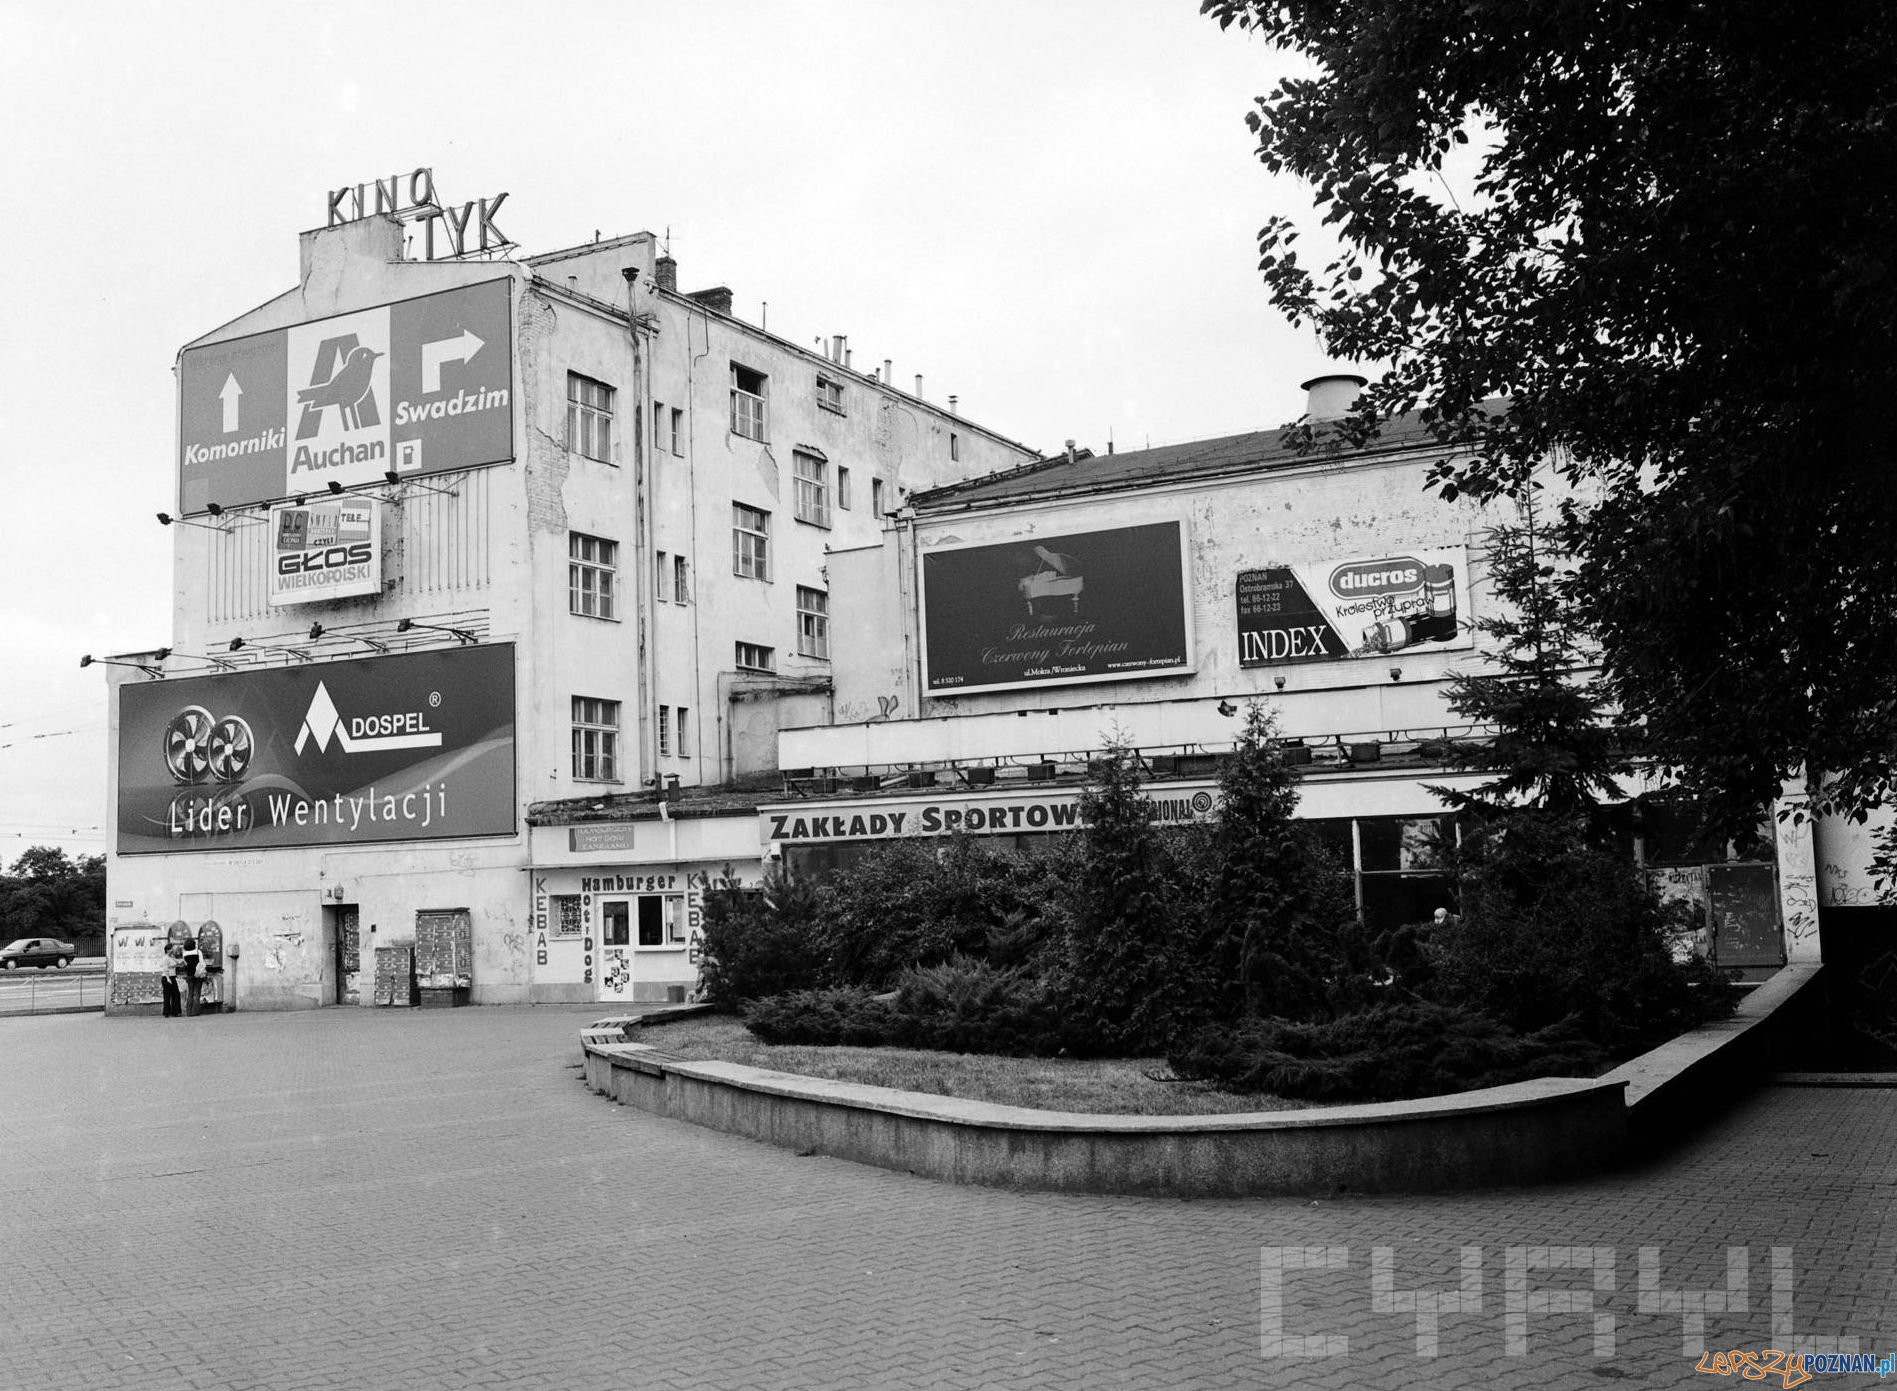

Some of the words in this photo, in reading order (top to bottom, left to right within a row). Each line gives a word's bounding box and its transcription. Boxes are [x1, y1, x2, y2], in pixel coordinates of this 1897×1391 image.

[327, 166, 432, 227] KINO
[394, 387, 510, 427] Swadzim
[184, 426, 287, 466] Komorniki
[290, 439, 386, 475] Auchan
[278, 542, 373, 576] GŁOS
[278, 564, 371, 591] WIELKOPOLSKI
[1339, 568, 1418, 590] ducros
[1006, 621, 1097, 643] Restauracja
[1241, 624, 1329, 661] INDEX
[980, 647, 1051, 665] Czerwony
[1055, 639, 1129, 660] Fortepian
[352, 712, 430, 737] DOSPEL
[171, 798, 248, 833] Lider
[267, 783, 446, 832] Wentylacji
[770, 811, 906, 840] ZAKŁADY
[921, 802, 1087, 832] SPORTOW
[581, 874, 676, 892] Hamburger
[536, 877, 548, 966] KEBAB
